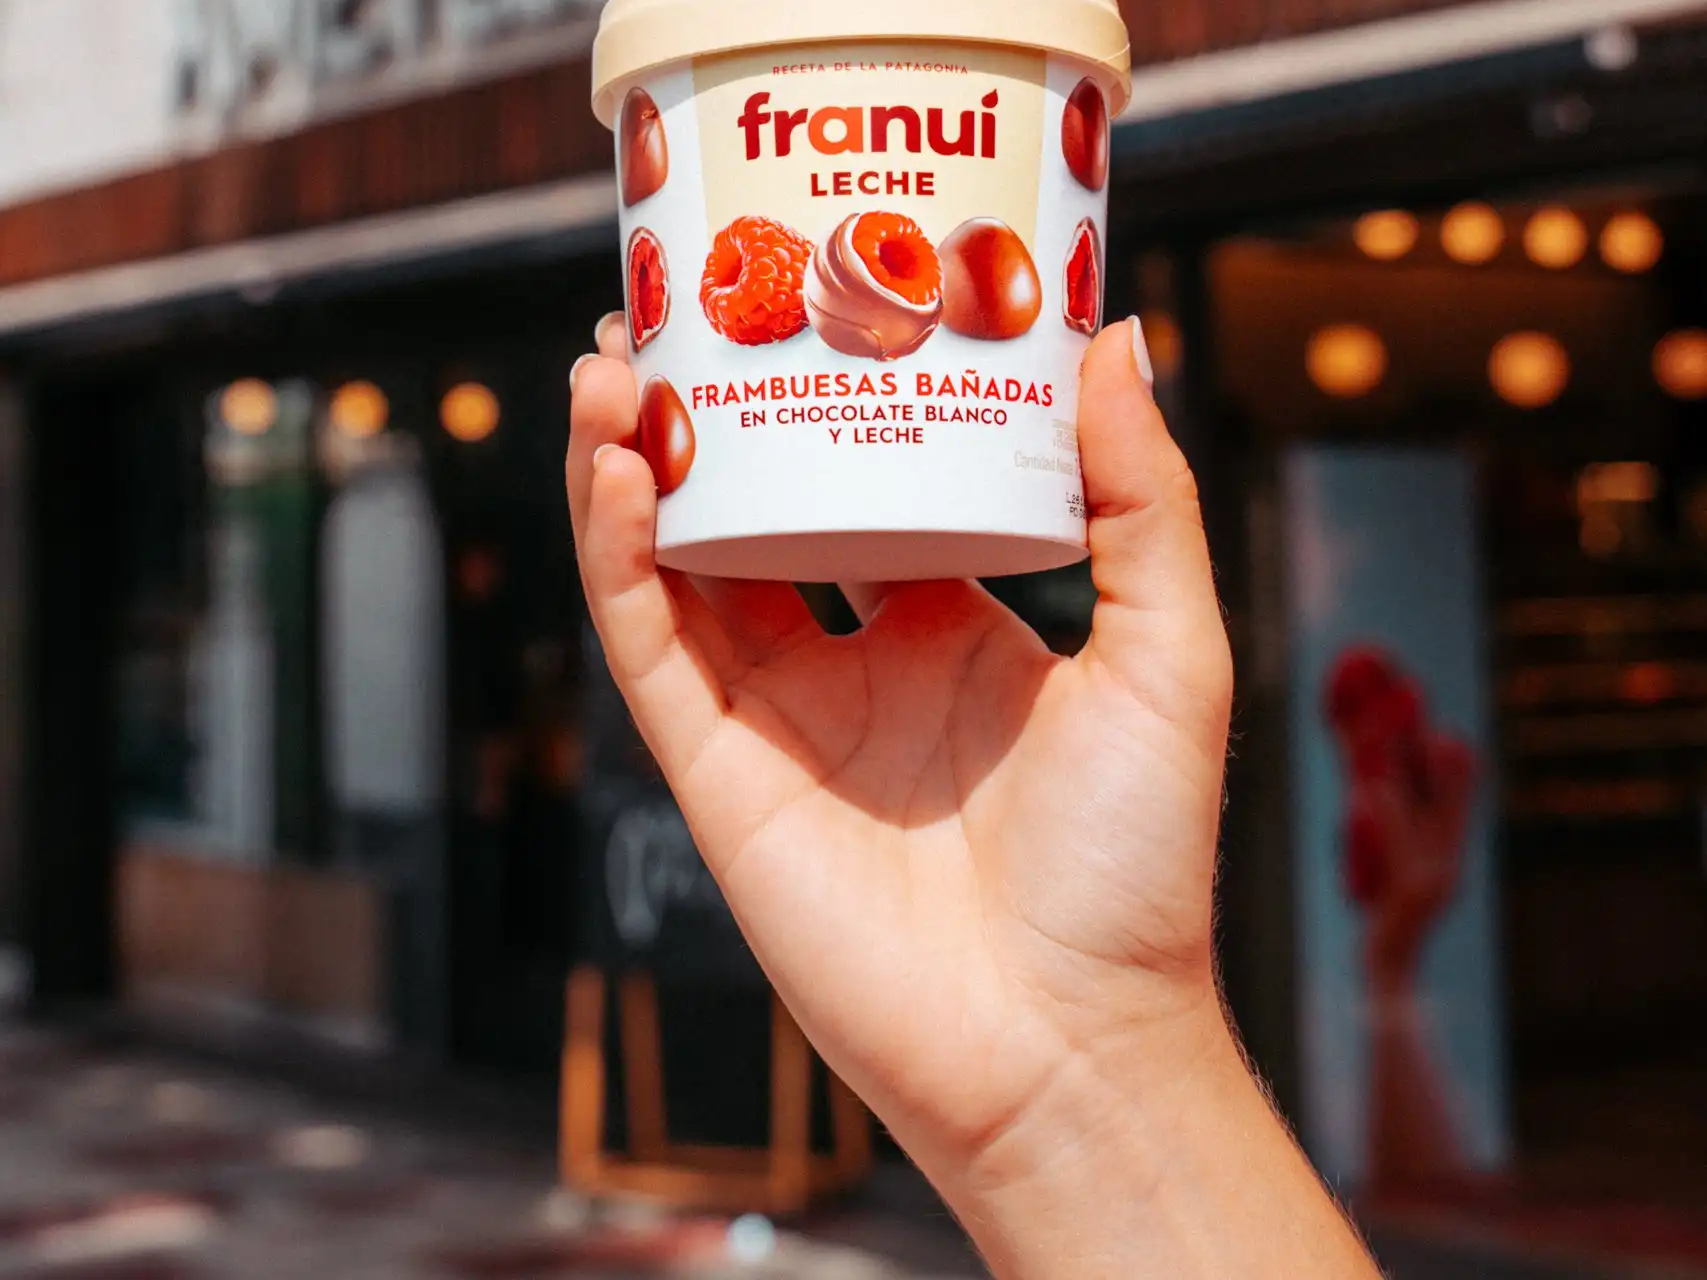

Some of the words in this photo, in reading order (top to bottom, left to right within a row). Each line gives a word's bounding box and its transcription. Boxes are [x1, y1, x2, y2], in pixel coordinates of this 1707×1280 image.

[772, 62, 825, 76] RECETA
[834, 61, 851, 71] DE
[860, 61, 877, 71] LA
[885, 61, 968, 75] PATAGONIA
[811, 171, 935, 196] LECHE
[692, 373, 898, 410] FRAMBUESAS
[915, 369, 1053, 407] BAÑADAS
[740, 411, 766, 428] EN
[776, 405, 914, 424] CHOCOLATE
[925, 407, 1007, 425] BLANCO
[828, 428, 842, 444] Y
[854, 428, 924, 444] LECHE
